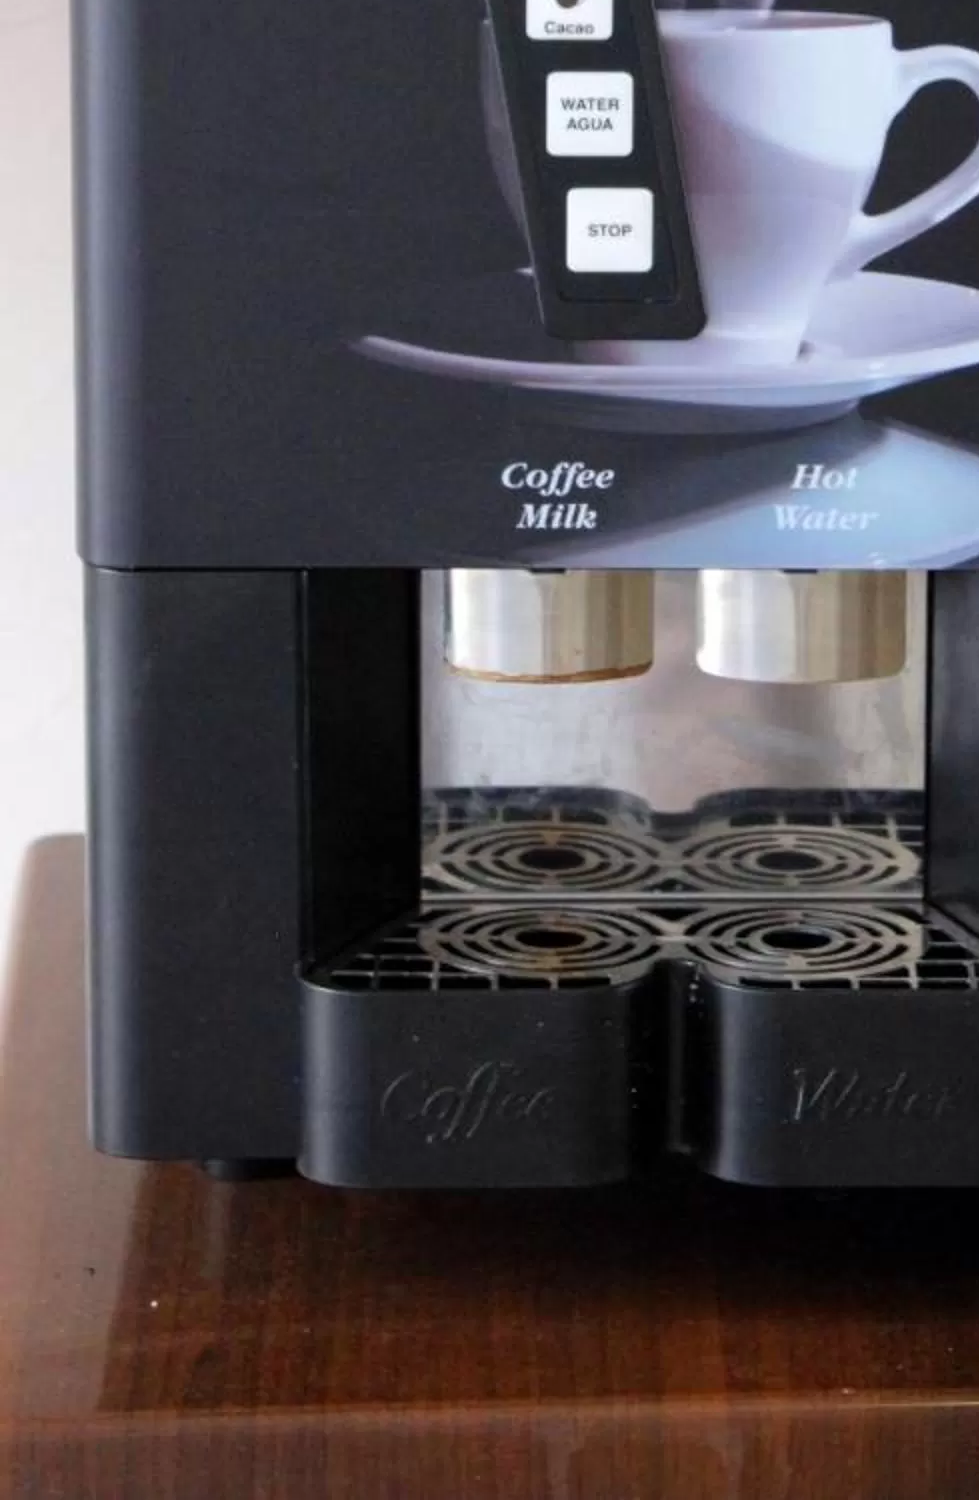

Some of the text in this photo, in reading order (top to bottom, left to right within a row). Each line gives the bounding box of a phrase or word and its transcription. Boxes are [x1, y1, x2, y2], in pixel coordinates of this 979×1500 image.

[543, 21, 595, 35] Cacao
[560, 97, 620, 112] WATER
[566, 117, 614, 132] AGUA
[586, 223, 633, 238] STOP
[500, 461, 616, 498] Coffee
[790, 463, 859, 491] Hot
[515, 504, 599, 530] Milk
[772, 504, 880, 531] Water
